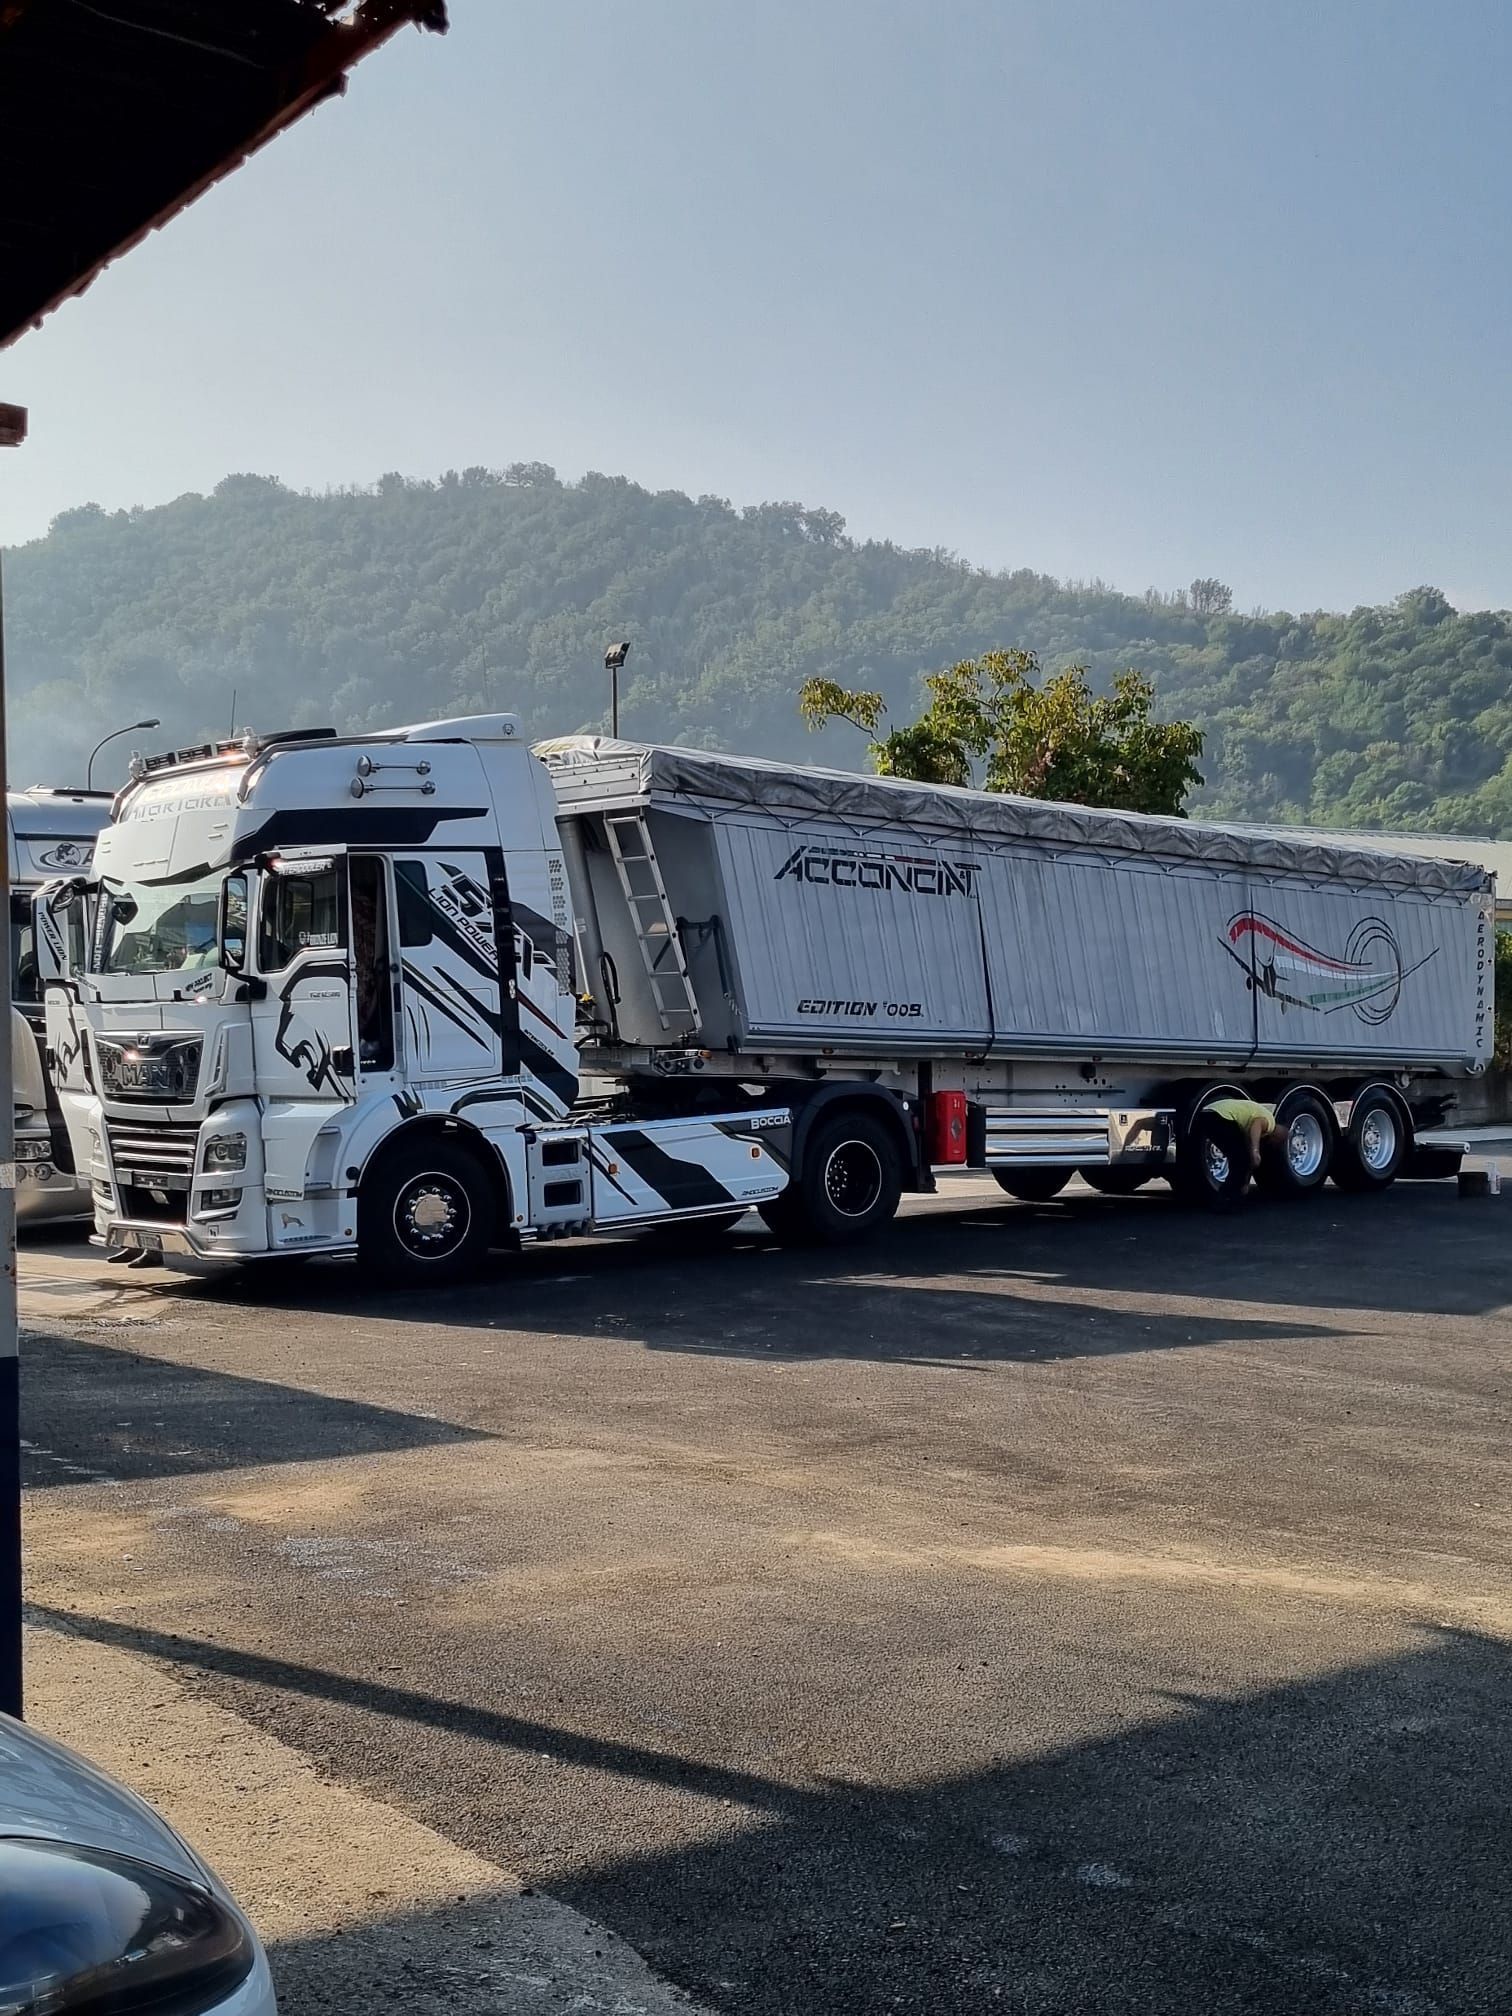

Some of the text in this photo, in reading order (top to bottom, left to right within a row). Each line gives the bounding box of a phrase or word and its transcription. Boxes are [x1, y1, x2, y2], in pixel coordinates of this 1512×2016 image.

[428, 887, 459, 917] LION
[38, 911, 68, 961] POWER LION
[1475, 911, 1485, 1048] AERODYNAMIC
[797, 999, 878, 1016] EDITION
[121, 1063, 170, 1089] MAN
[750, 1115, 791, 1129] BOCCIA
